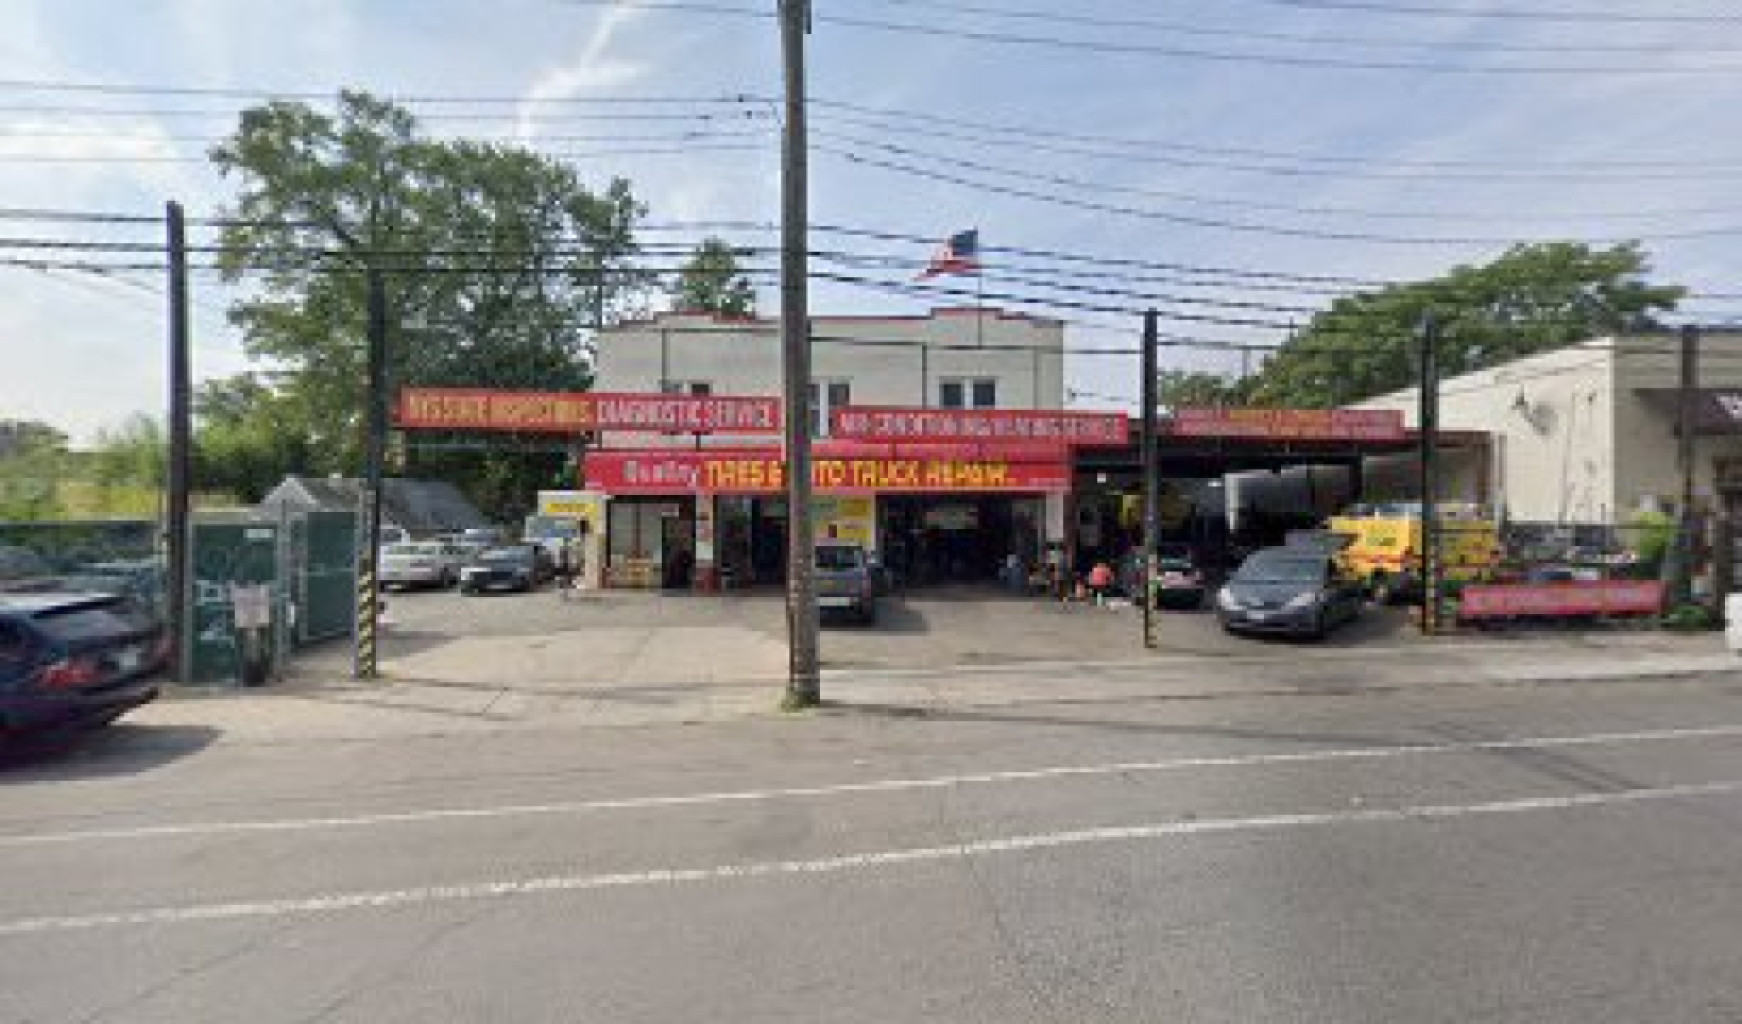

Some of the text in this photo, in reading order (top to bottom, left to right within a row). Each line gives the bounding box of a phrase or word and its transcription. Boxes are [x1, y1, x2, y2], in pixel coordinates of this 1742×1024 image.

[597, 396, 774, 424] DIAGNOSTIC SERVICE
[624, 461, 697, 488] Quality
[705, 460, 763, 487] TIRES
[852, 460, 921, 488] TRUCK
